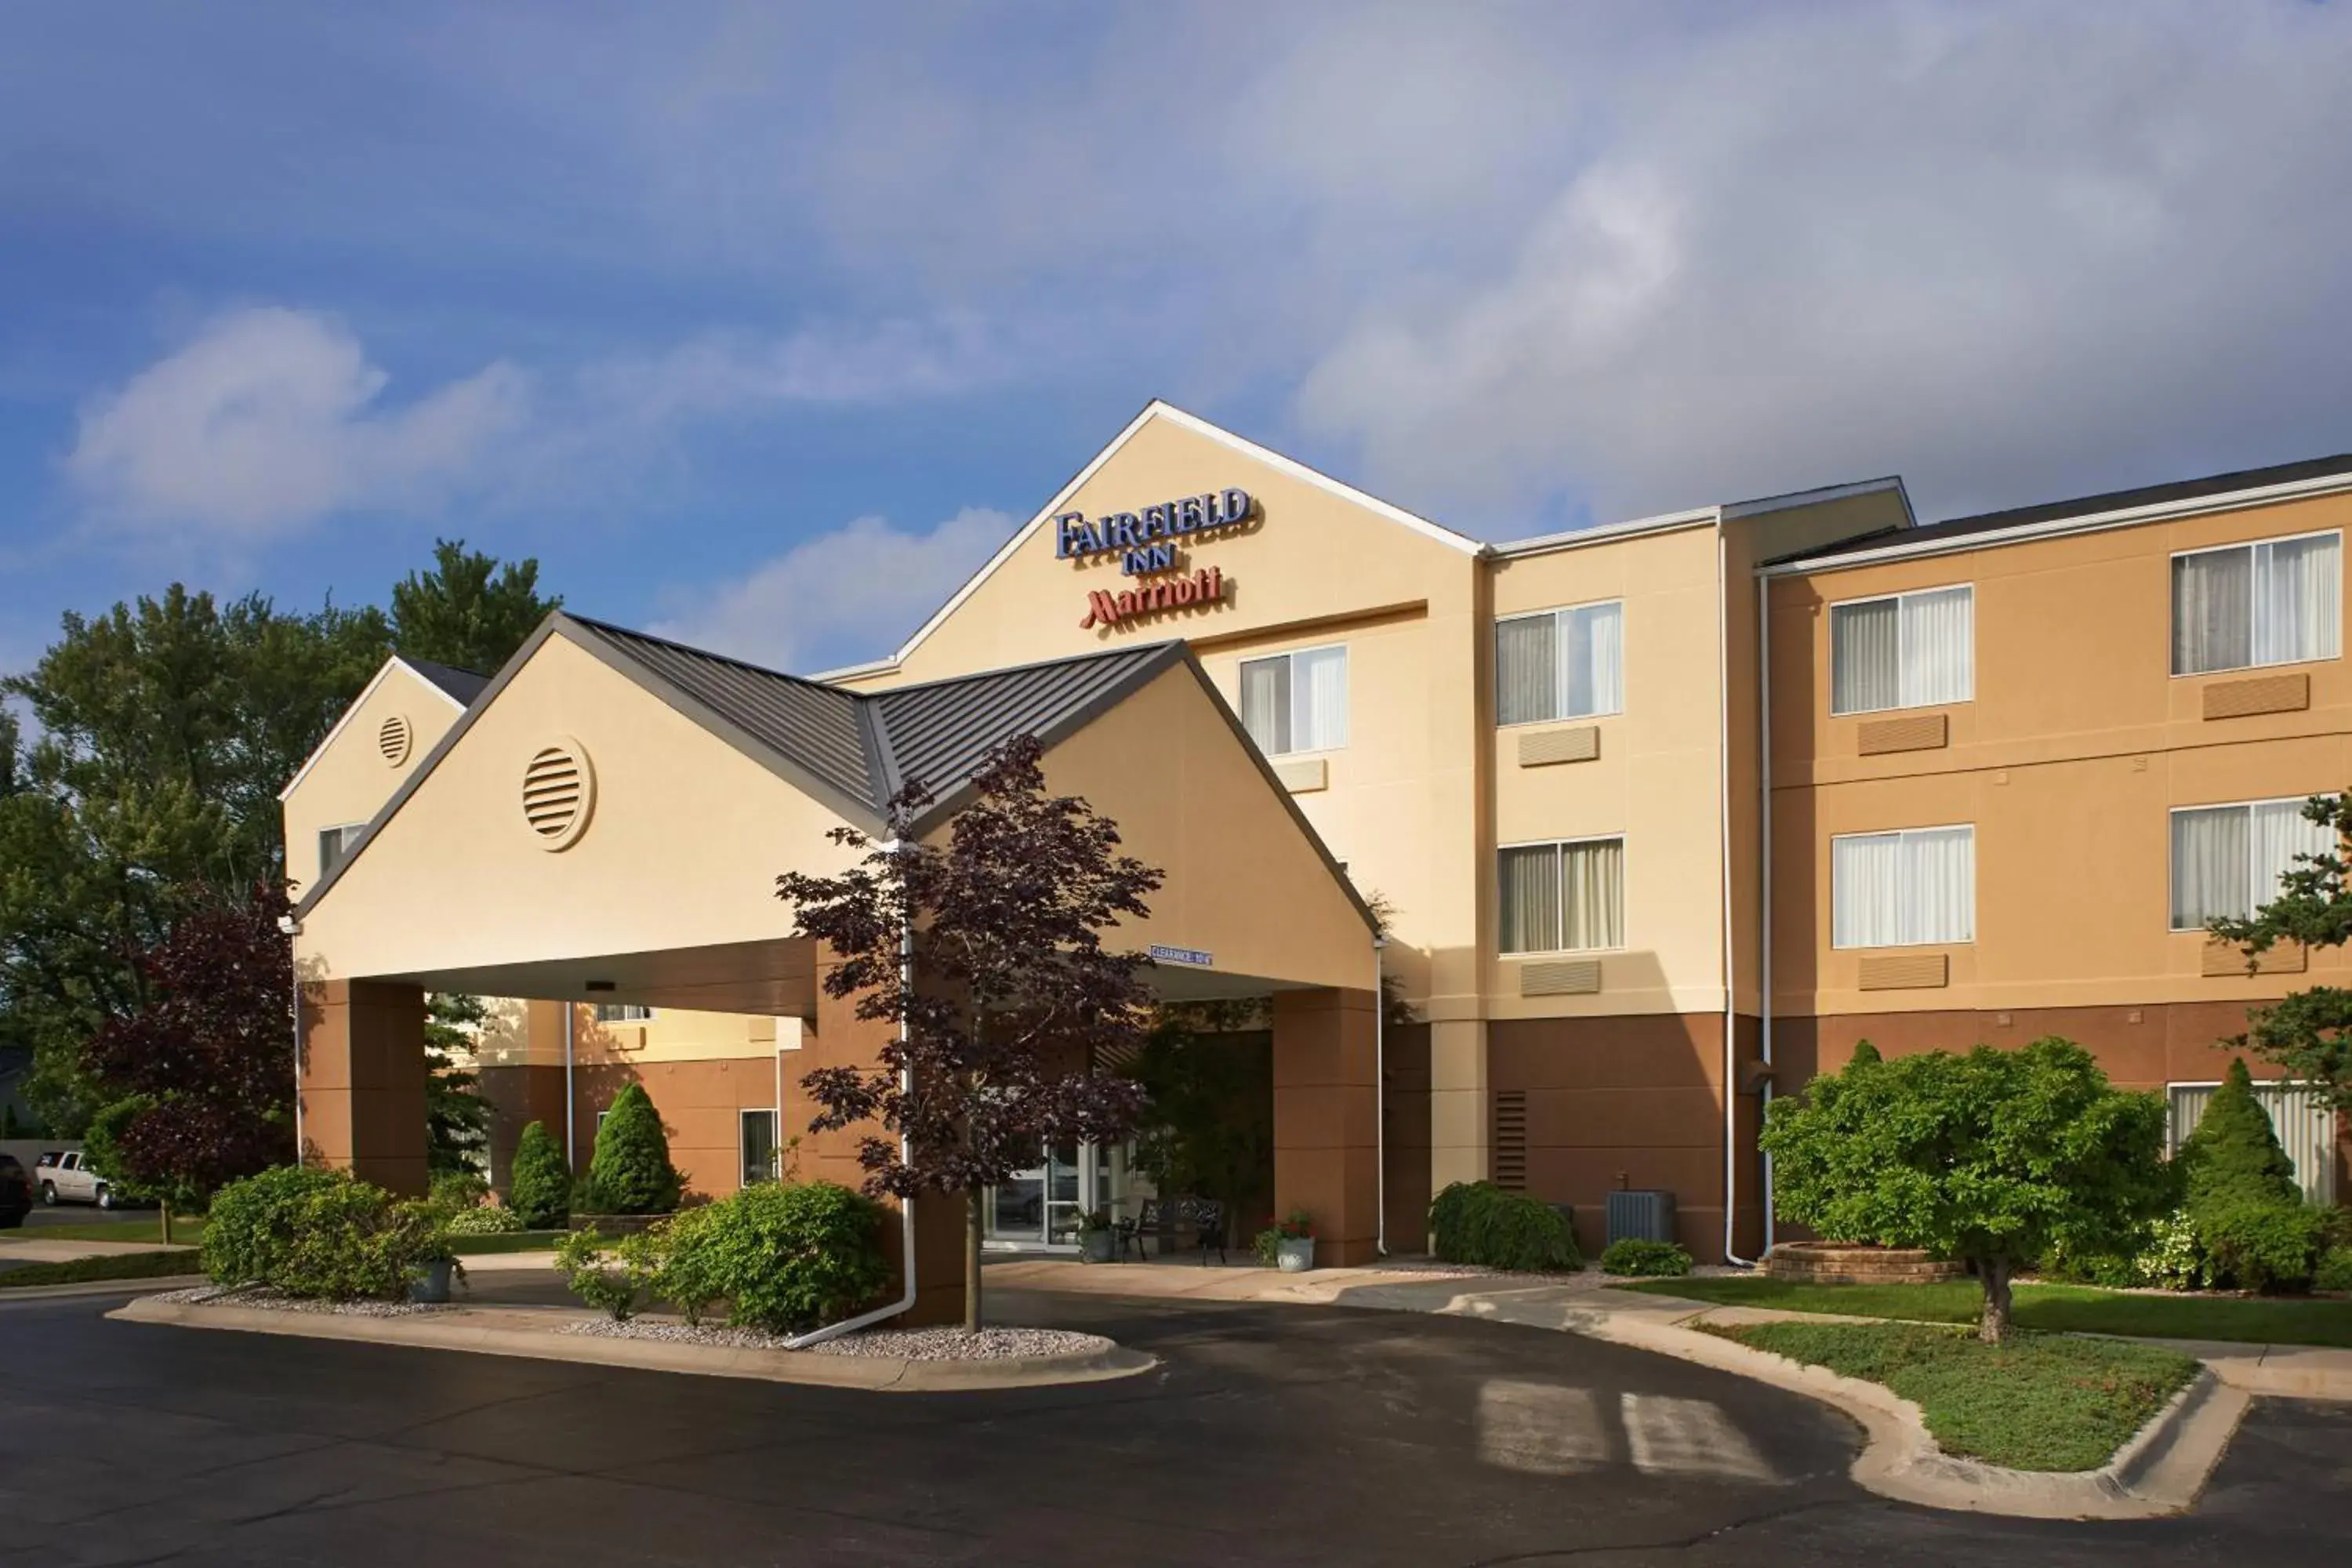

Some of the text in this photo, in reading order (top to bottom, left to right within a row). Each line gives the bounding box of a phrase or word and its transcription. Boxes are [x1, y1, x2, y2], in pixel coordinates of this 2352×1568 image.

[1053, 487, 1252, 560] FAIRFIELD
[1120, 542, 1176, 576] INN
[1080, 565, 1222, 629] Marriott
